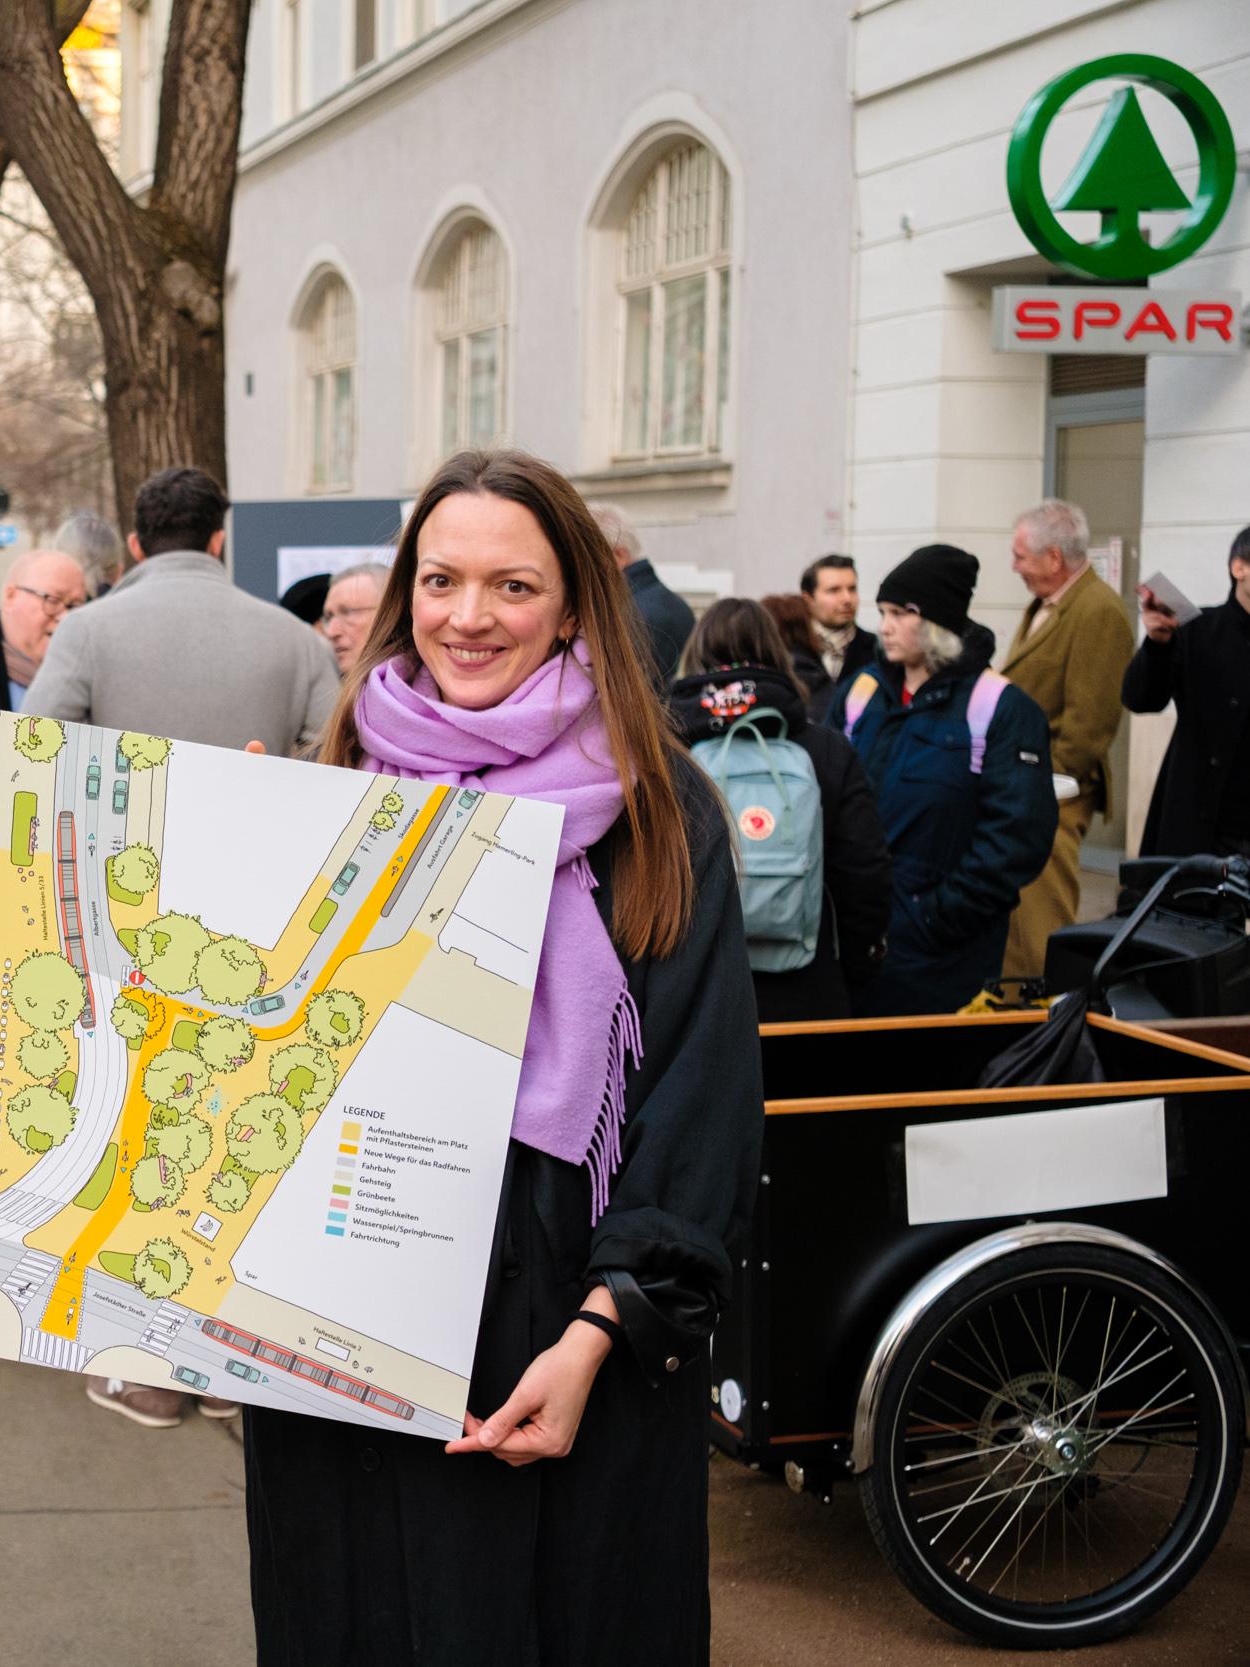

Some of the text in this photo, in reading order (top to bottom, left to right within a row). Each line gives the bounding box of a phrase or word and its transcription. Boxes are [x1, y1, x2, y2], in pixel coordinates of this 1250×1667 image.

[1015, 300, 1233, 341] SPAR
[398, 808, 420, 839] Skodagasse
[427, 825, 454, 869] Ausfahrt Garage
[471, 831, 492, 847] Zugang
[91, 901, 99, 936] Albertgasse
[343, 1105, 386, 1120] LEGENDE
[366, 1135, 434, 1153] mit Pflastersteinen
[367, 1126, 436, 1144] Aufenthaltsbereich
[450, 1140, 468, 1150] Platz
[361, 1162, 396, 1174] Fahrbahn
[364, 1148, 471, 1174] Neue Wege für das Radfahren
[359, 1176, 392, 1189] Gehsteig
[357, 1190, 396, 1203] Grünbeete
[355, 1203, 419, 1221] Sitzmöglichkeiten
[181, 1228, 216, 1252] Würstelstand
[350, 1231, 400, 1248] Fahrtrichtung
[352, 1217, 454, 1242] Wasserspiel/Springbrunnen
[245, 1270, 258, 1281] Spar
[92, 1292, 147, 1318] Josefstädter Straße
[313, 1326, 342, 1343] Haltestelle
[343, 1339, 357, 1350] Linie
